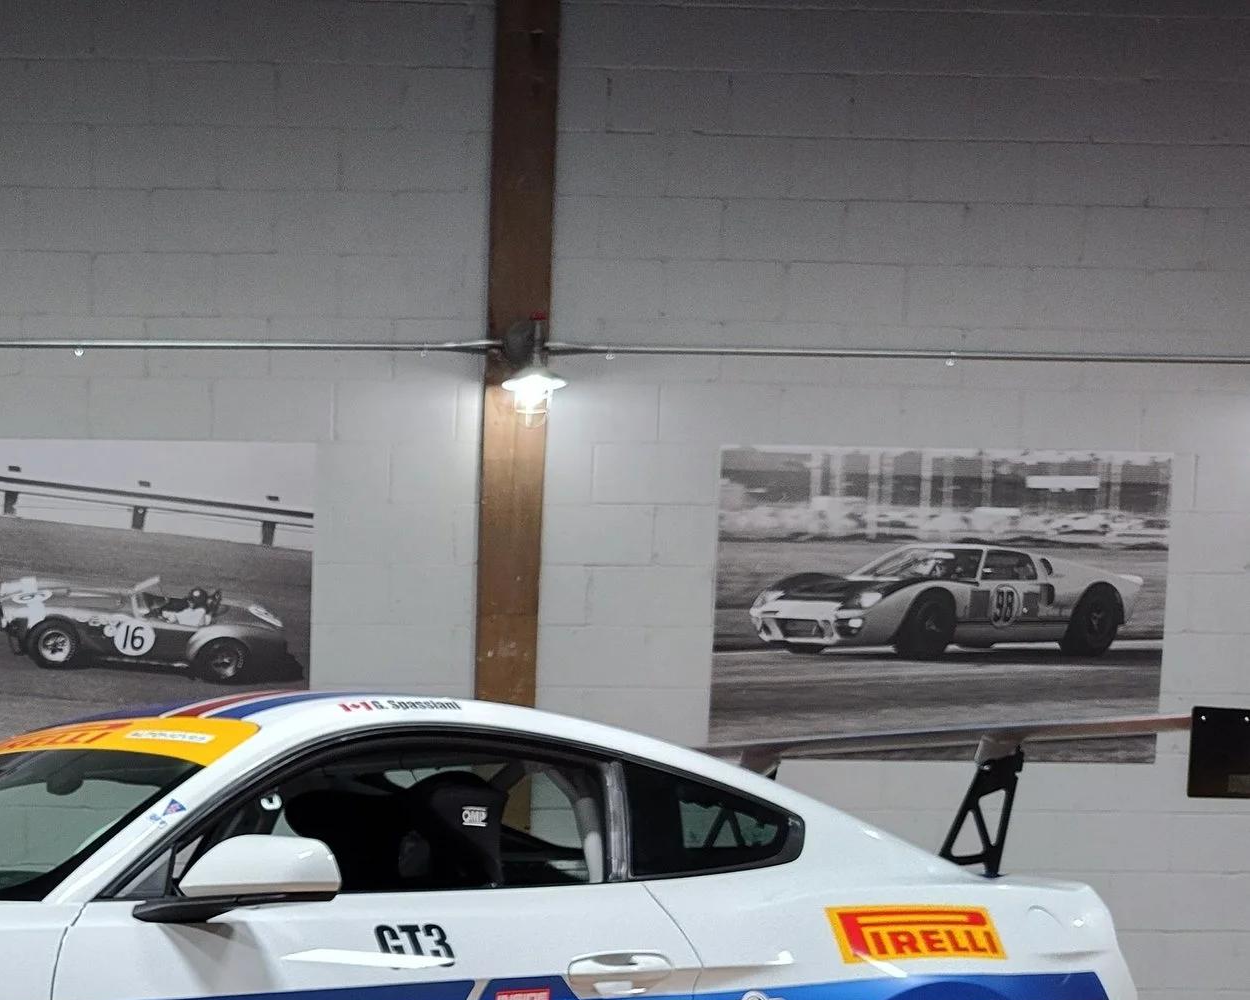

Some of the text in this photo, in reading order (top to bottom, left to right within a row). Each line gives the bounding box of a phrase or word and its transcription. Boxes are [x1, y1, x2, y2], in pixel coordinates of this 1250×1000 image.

[122, 624, 145, 651] 16
[373, 923, 456, 970] GT3
[836, 910, 999, 958] PIRELLI
